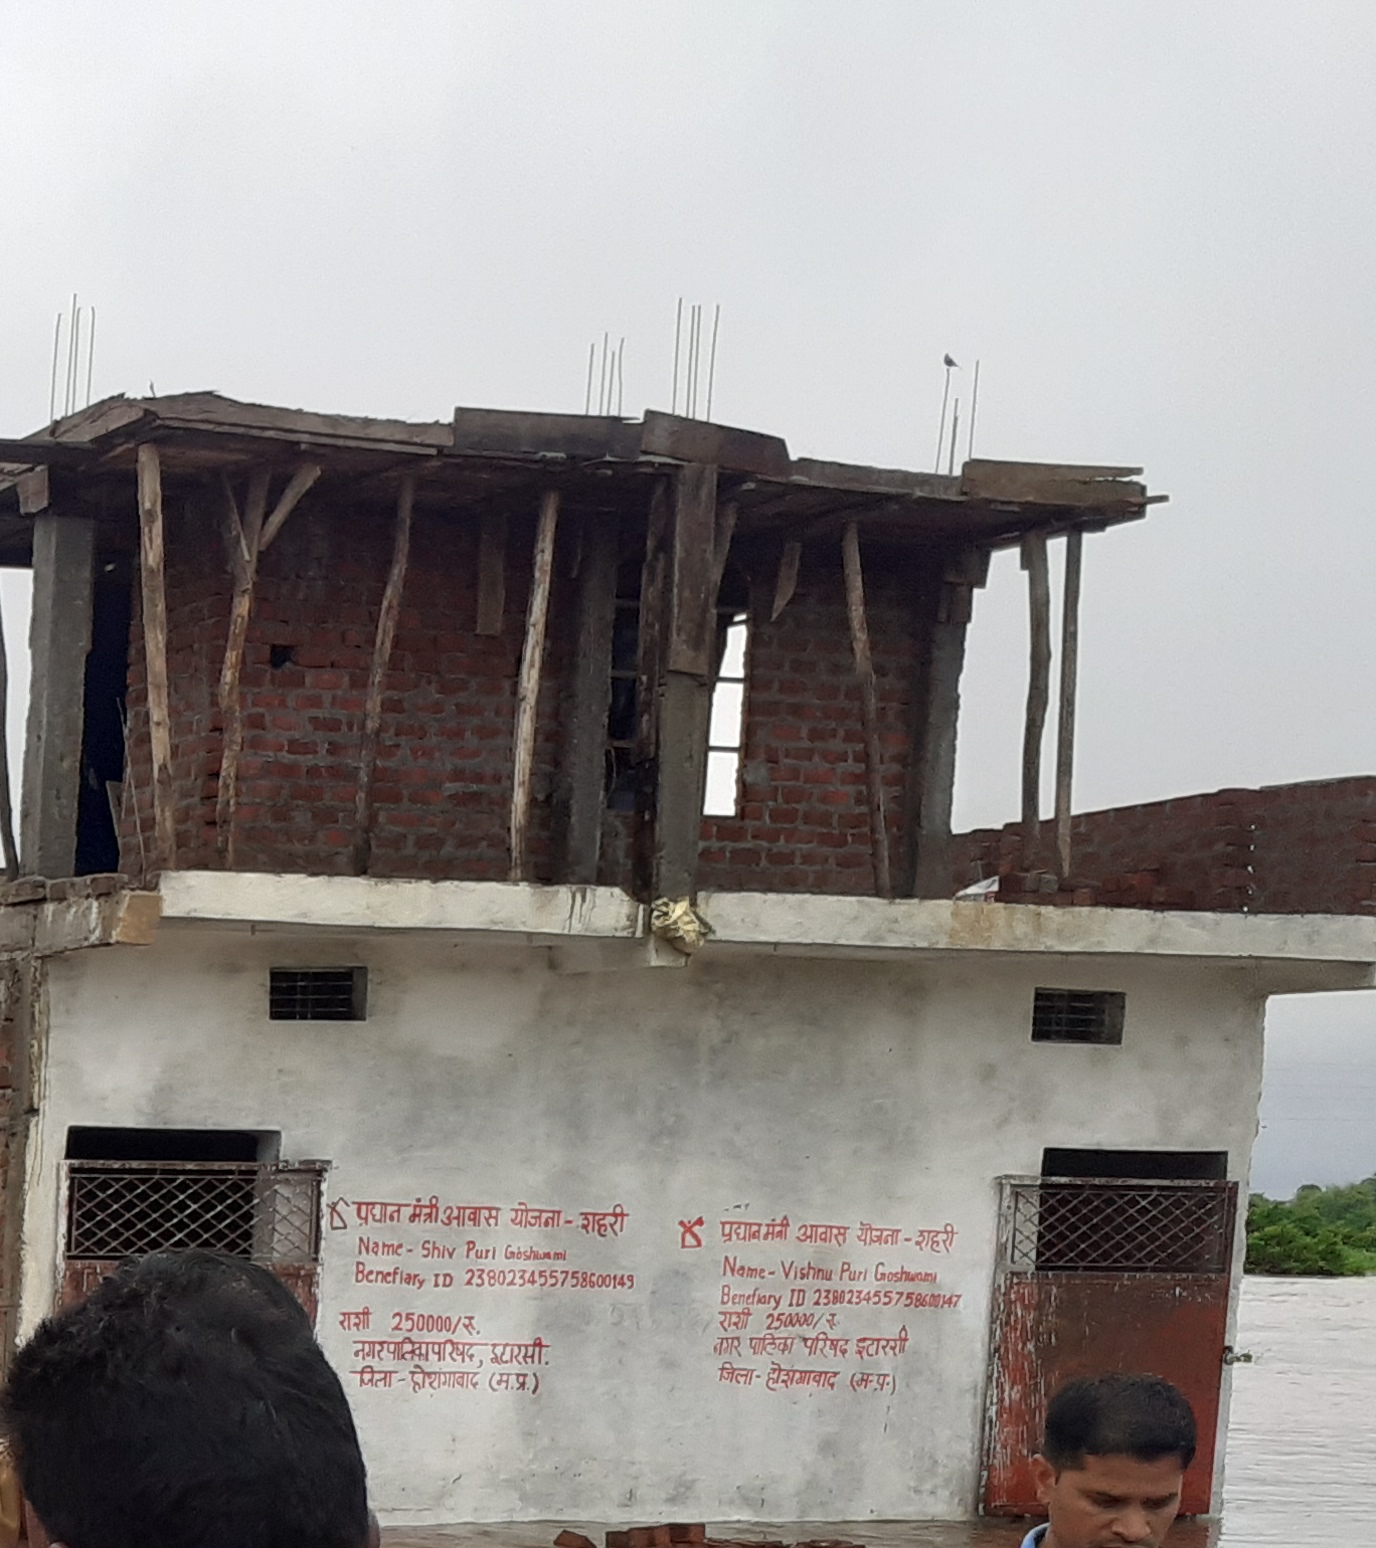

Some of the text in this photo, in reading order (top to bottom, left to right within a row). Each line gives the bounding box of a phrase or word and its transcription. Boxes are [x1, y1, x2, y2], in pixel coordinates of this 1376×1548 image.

[796, 1223, 850, 1247] आवास
[421, 1240, 457, 1260] Shiv
[465, 1239, 496, 1260] Puri
[504, 1244, 567, 1261] Goshwami
[433, 1273, 454, 1289] ID
[780, 1260, 833, 1281] Vishnu
[839, 1260, 868, 1282] Puri
[874, 1262, 938, 1284] Goshwami
[788, 1288, 806, 1308] ID
